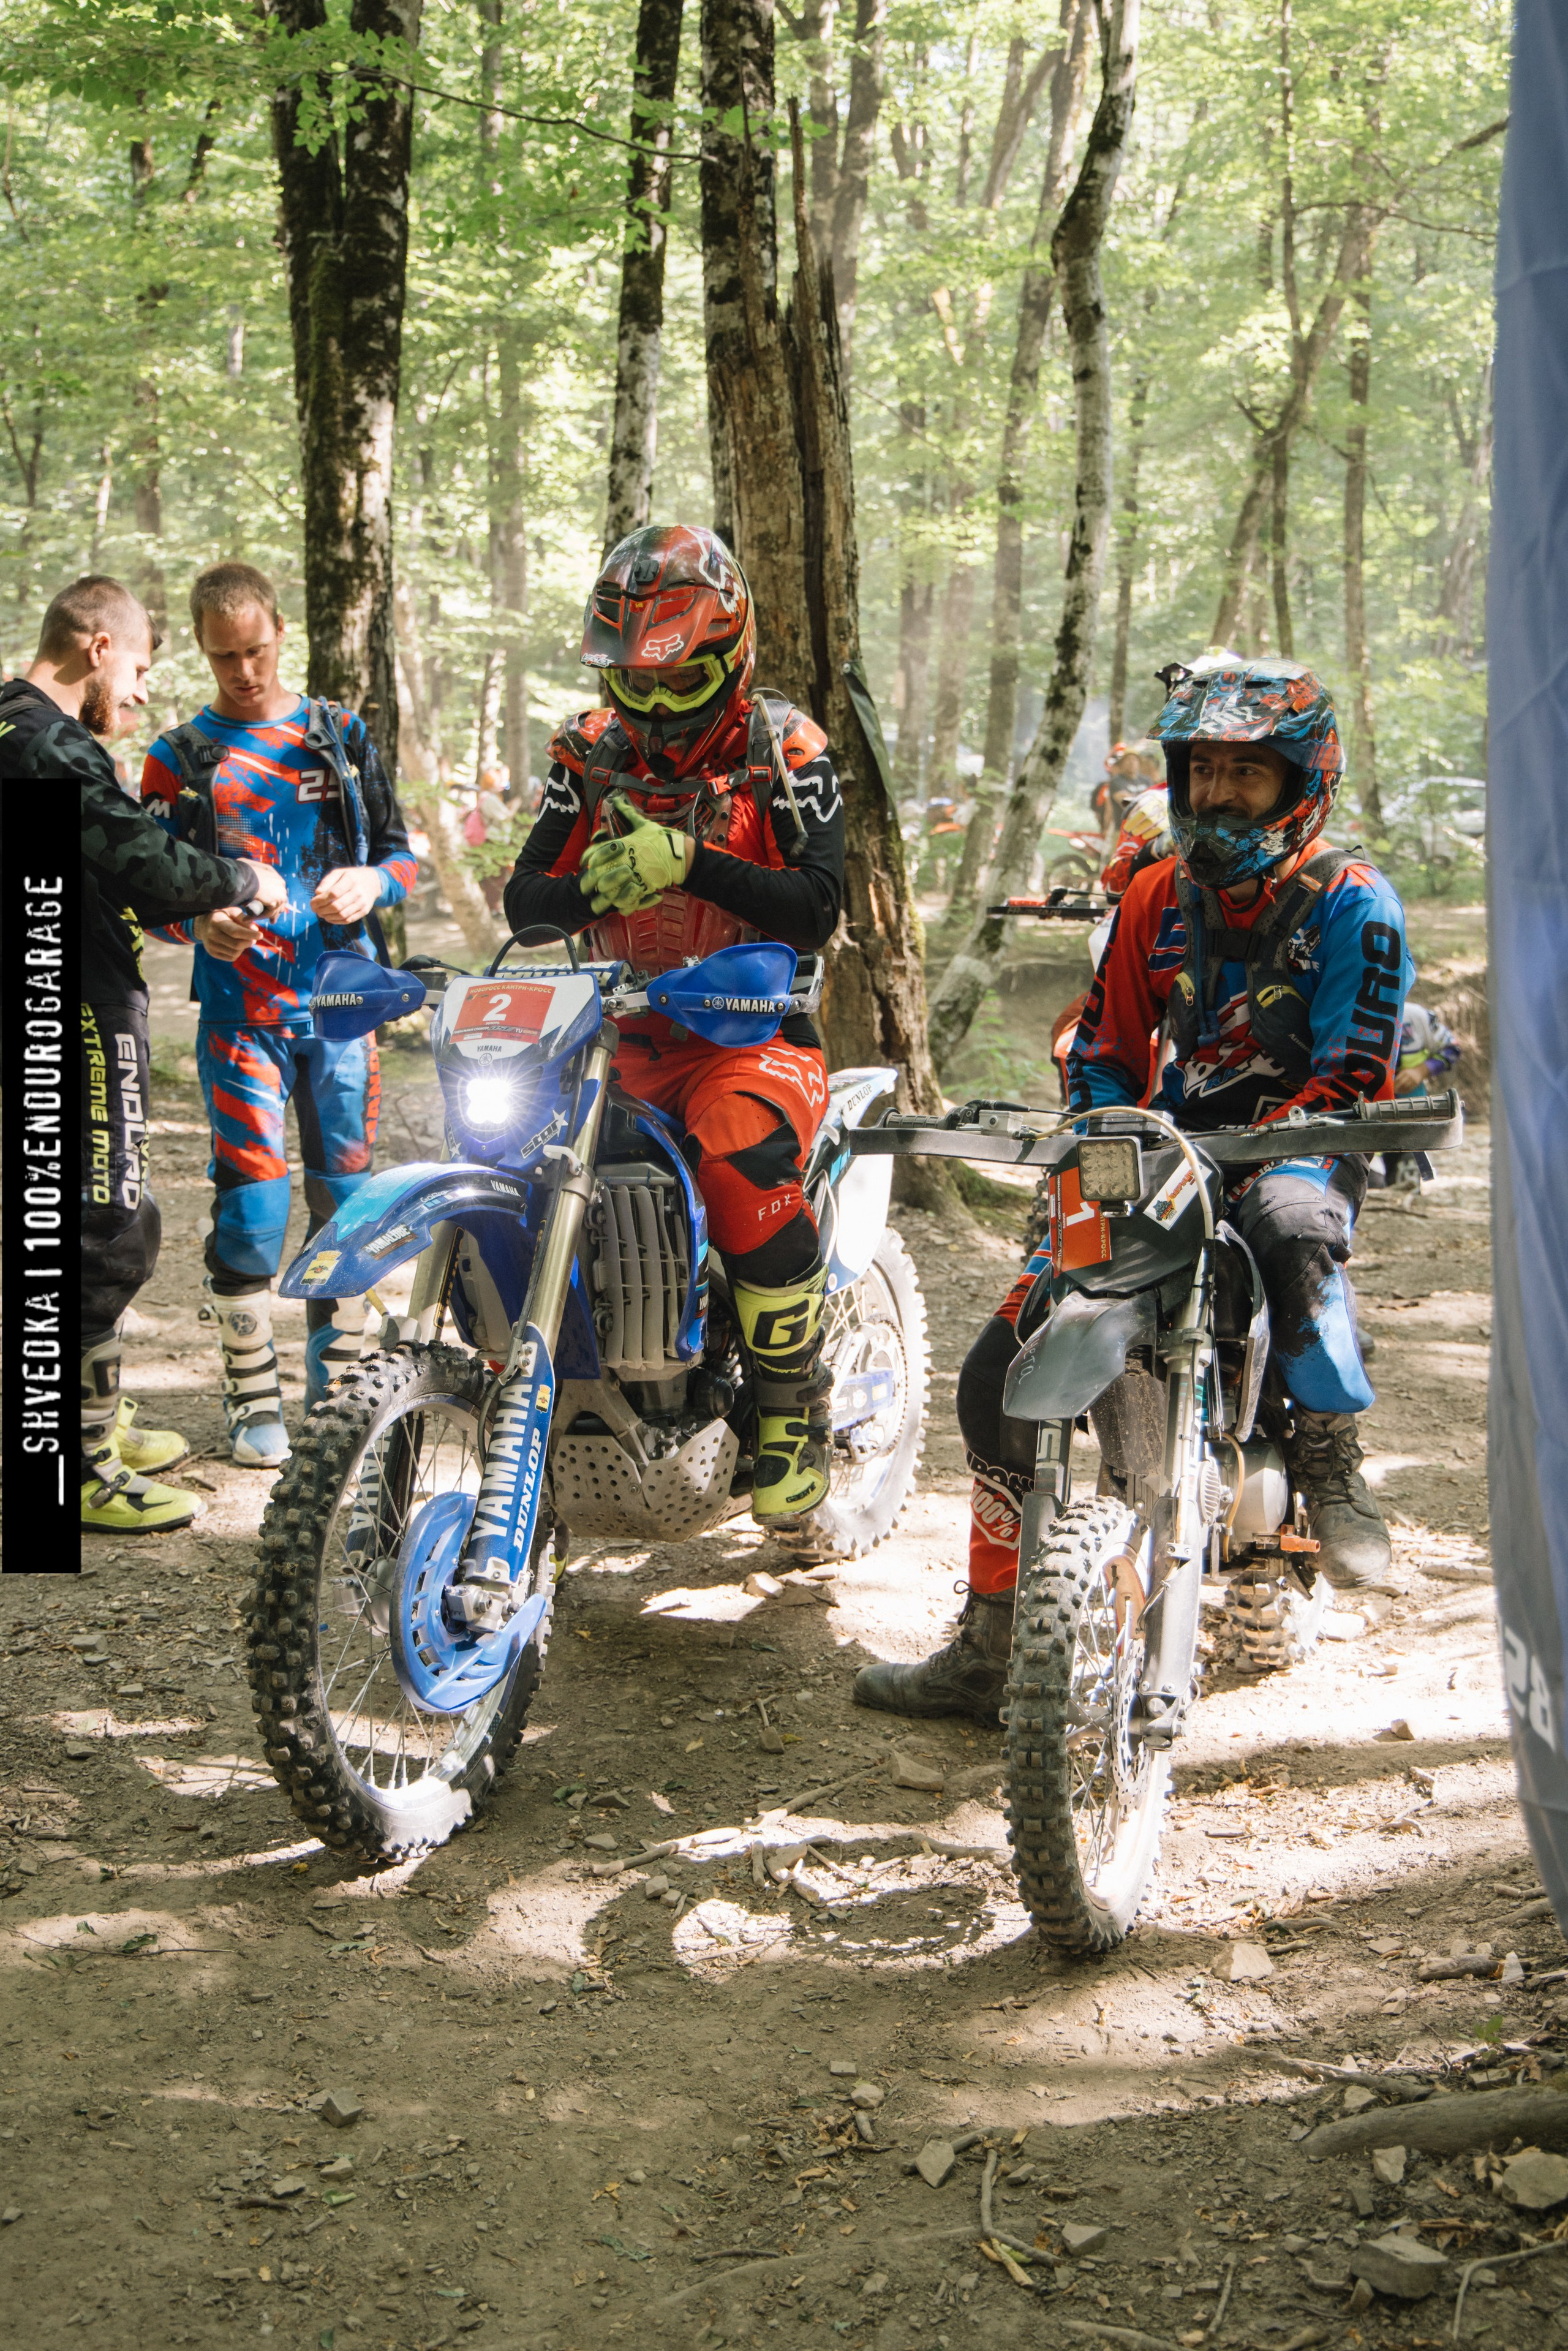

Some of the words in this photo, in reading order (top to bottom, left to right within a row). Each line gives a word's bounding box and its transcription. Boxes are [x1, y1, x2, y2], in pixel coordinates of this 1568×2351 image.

[316, 994, 356, 1008] YAMAHA
[482, 994, 511, 1021] 2
[725, 998, 775, 1013] YAMAHA
[847, 1084, 872, 1111] DUNLOP
[491, 1180, 521, 1198] YAMAHA
[758, 1193, 791, 1221] FOX
[1066, 1201, 1095, 1226] 1
[365, 1224, 412, 1253] YAMALUBE
[752, 1299, 810, 1349] G
[470, 1384, 533, 1542] YAMAHA
[513, 1427, 543, 1553] DUNLOP
